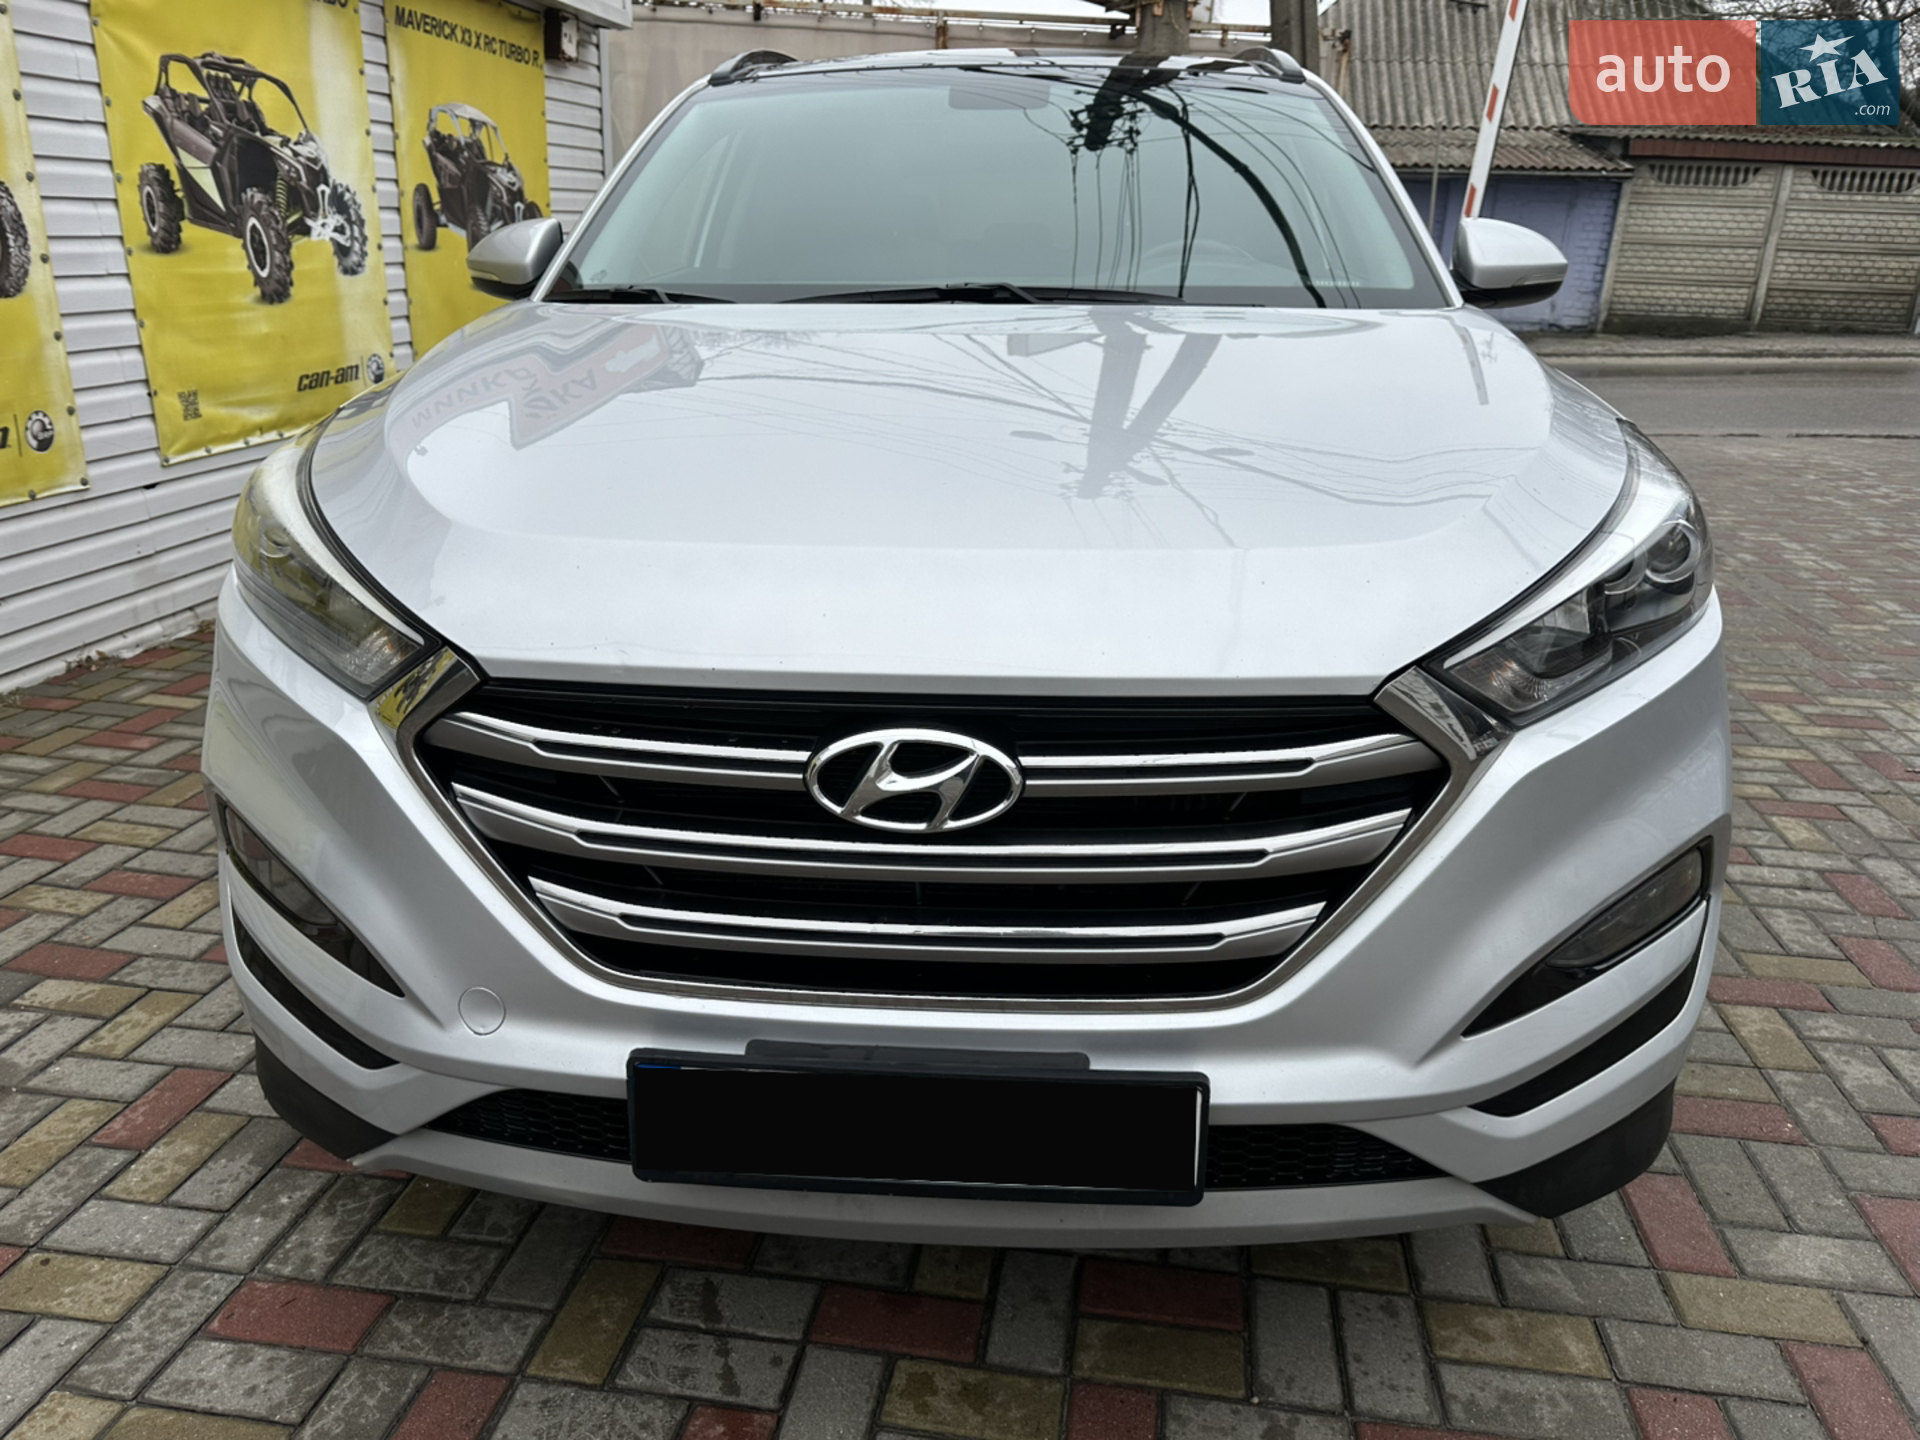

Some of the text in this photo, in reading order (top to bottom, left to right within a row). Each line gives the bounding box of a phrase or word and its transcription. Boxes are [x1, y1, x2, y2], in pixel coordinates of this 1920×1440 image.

[394, 5, 459, 43] MAVERICK
[459, 26, 473, 48] X3
[473, 30, 483, 51] X
[498, 39, 531, 65] TURBO
[297, 364, 359, 392] can-am
